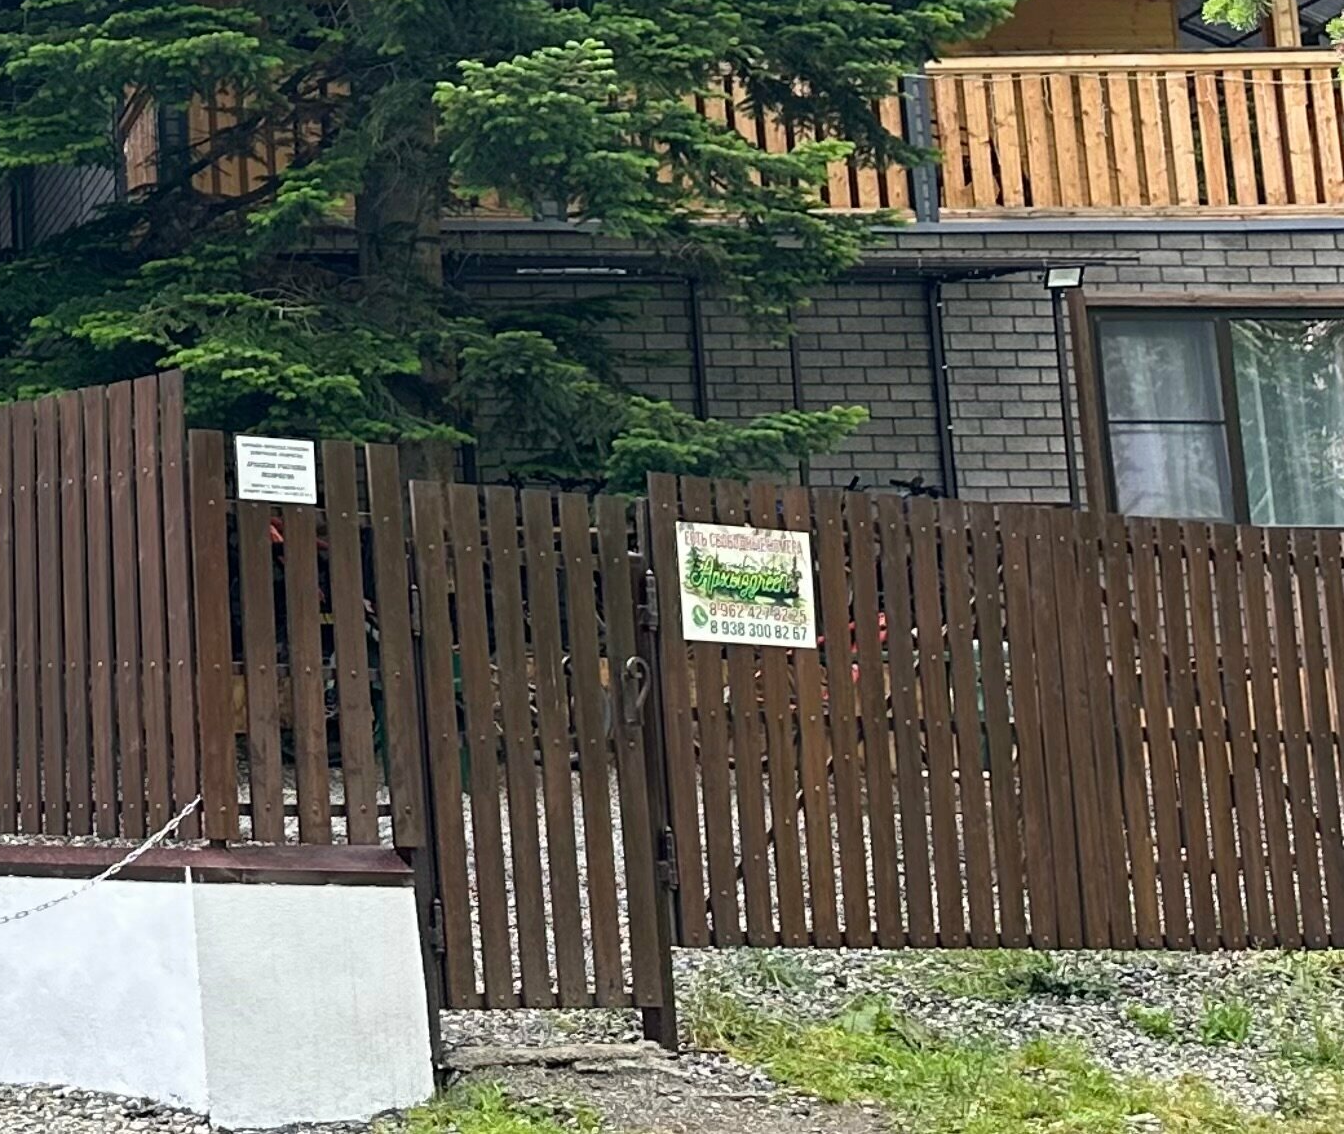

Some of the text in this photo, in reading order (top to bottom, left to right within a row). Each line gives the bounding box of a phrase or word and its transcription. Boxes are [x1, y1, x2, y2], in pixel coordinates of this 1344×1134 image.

[684, 530, 708, 547] ЕСТЬ
[709, 602, 807, 624] 8 962 427 82 25
[710, 619, 807, 641] 8 938 300 82 67
